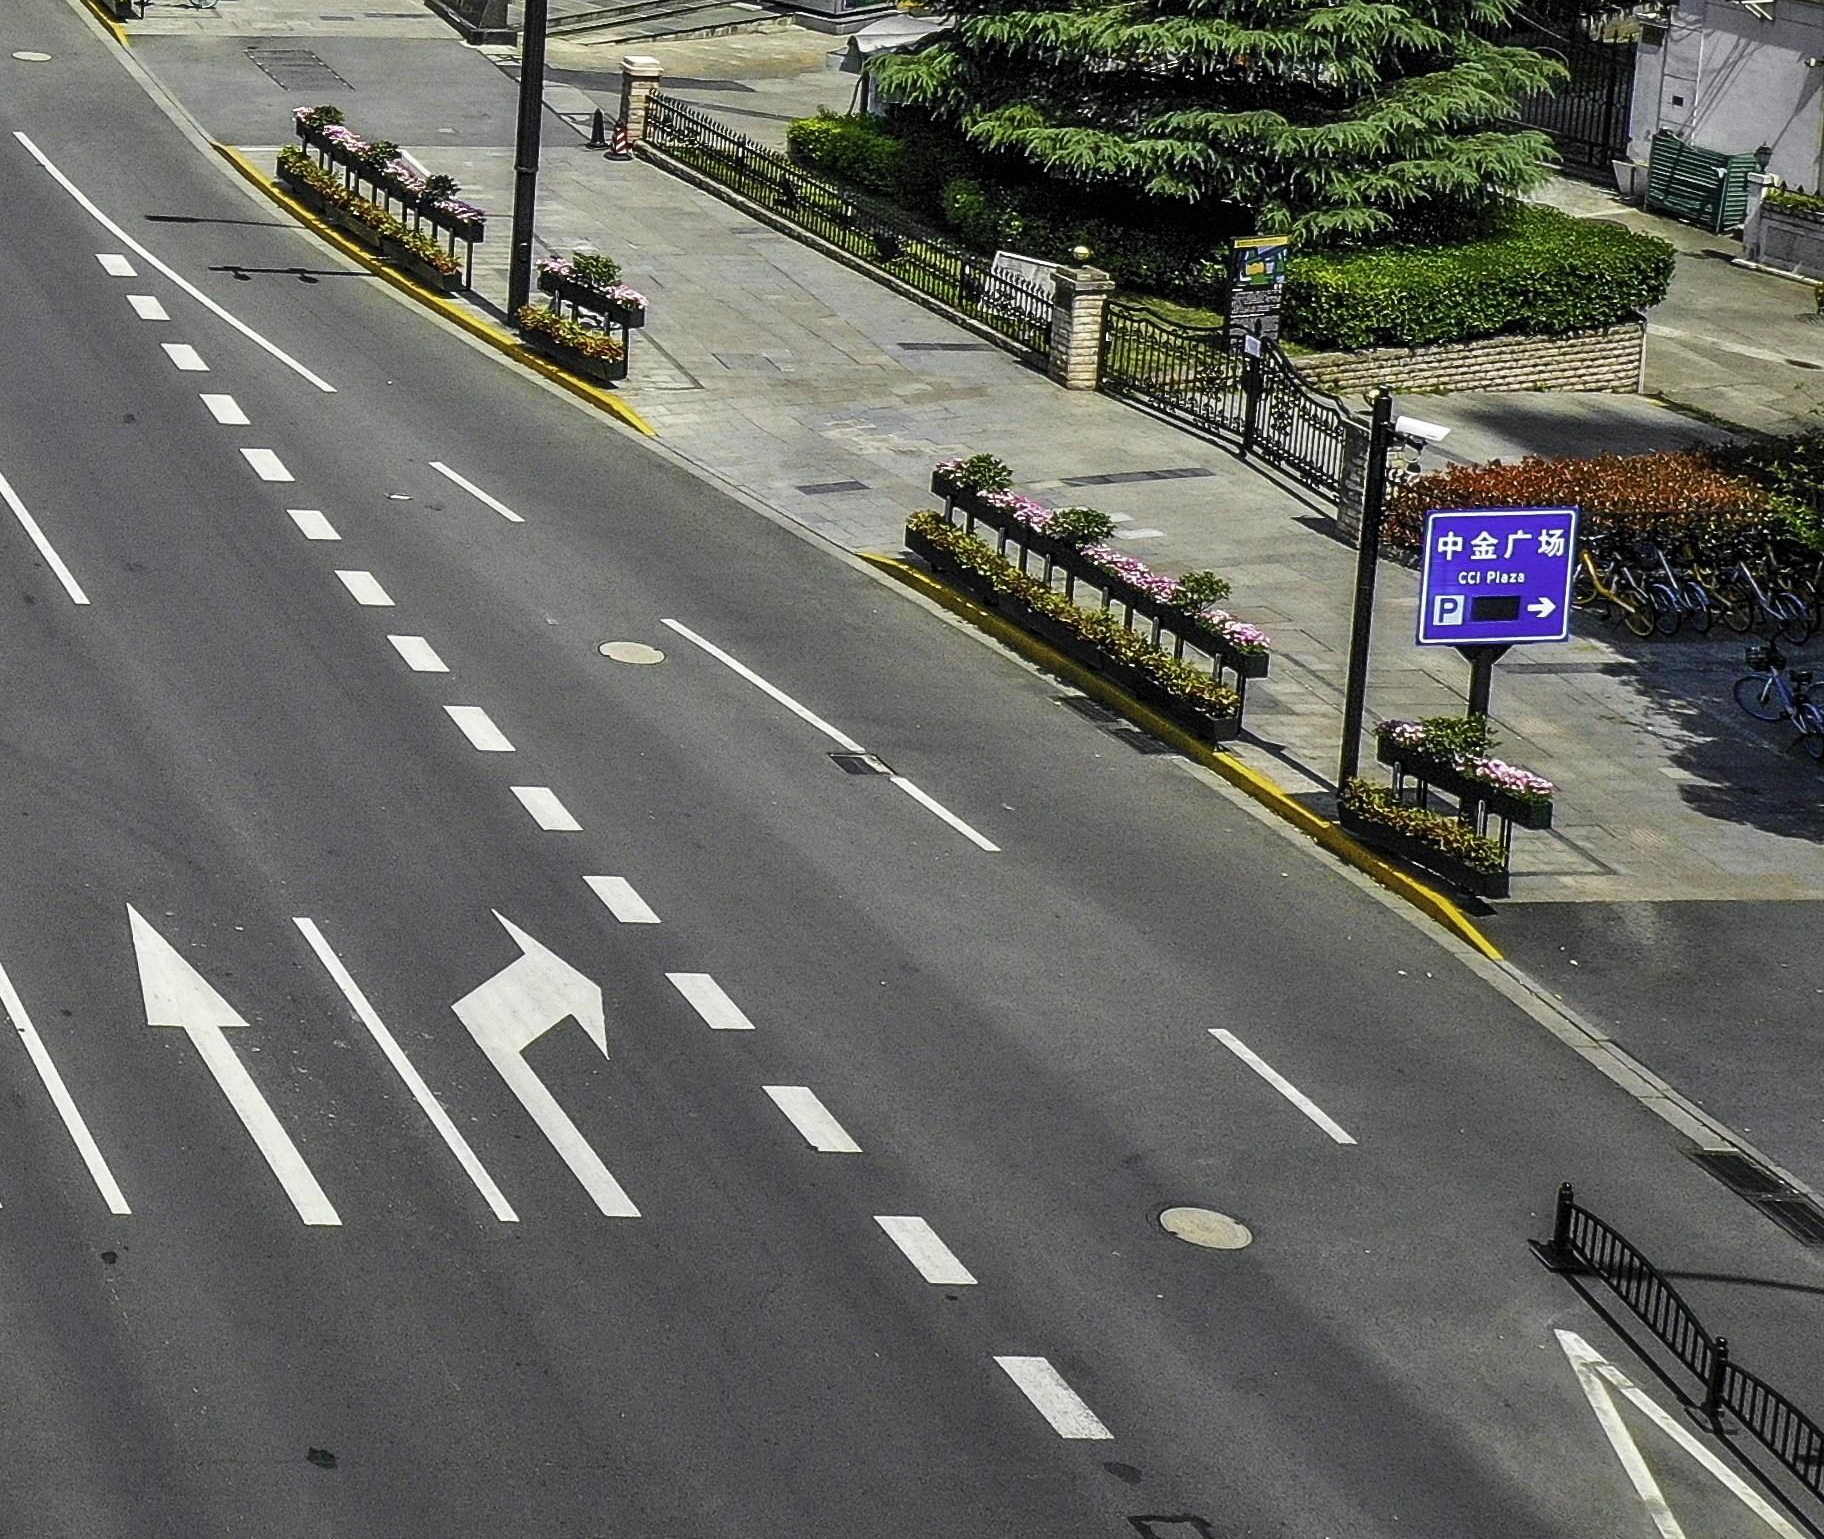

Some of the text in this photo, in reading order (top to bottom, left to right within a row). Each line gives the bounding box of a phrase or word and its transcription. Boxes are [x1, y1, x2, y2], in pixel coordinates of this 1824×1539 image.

[1437, 528, 1567, 562] 中金广场
[1458, 570, 1526, 586] CCI Plaza
[1439, 598, 1459, 624] P
